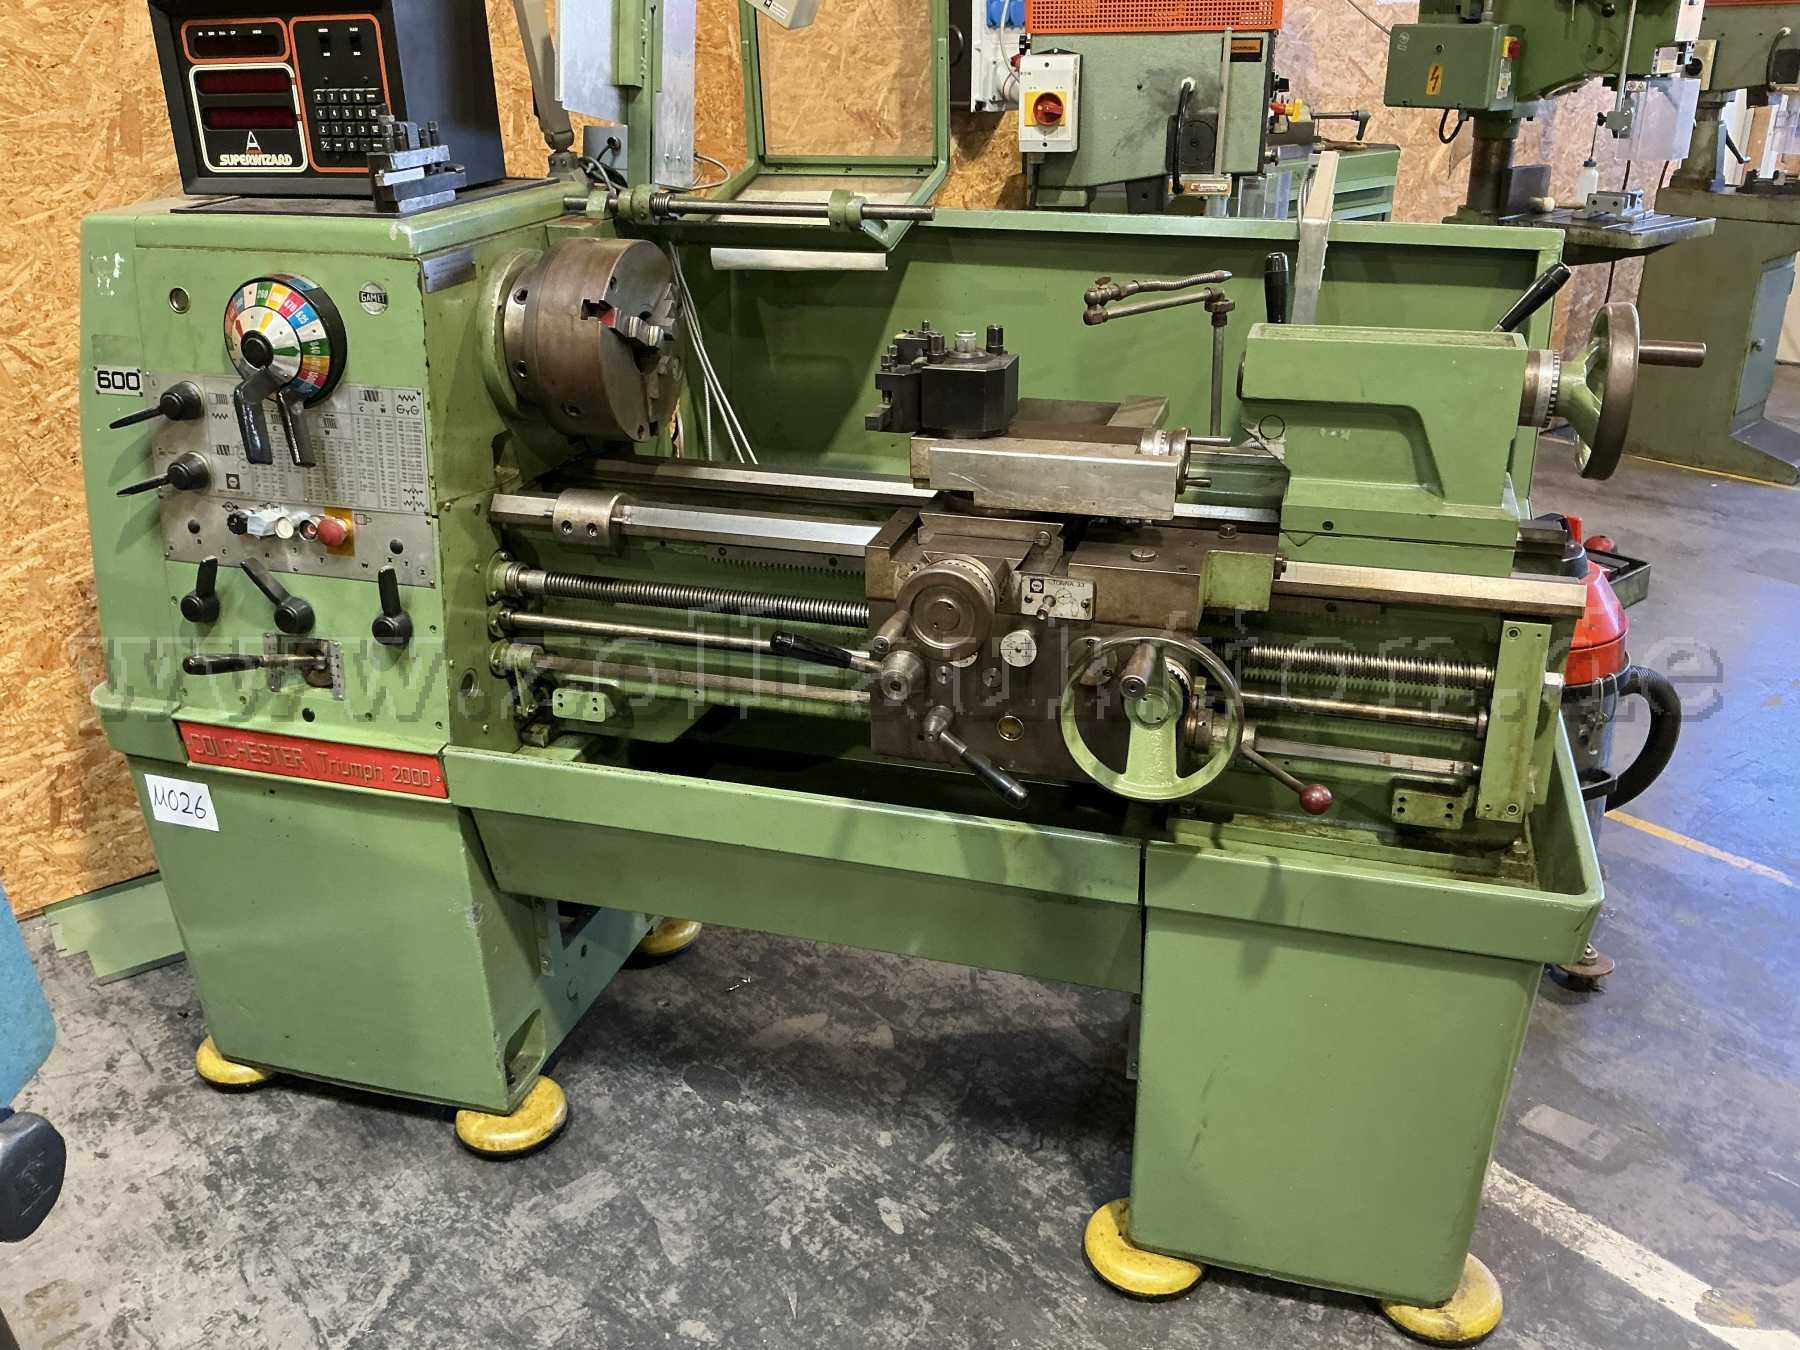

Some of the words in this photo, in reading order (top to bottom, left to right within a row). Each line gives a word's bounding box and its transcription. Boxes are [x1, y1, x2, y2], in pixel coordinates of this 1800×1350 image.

[219, 153, 293, 167] SUPERWIZARD
[96, 370, 141, 391] 600
[188, 733, 307, 770] COLCHESTER
[315, 751, 385, 783] Triumph
[391, 765, 433, 787] 2000
